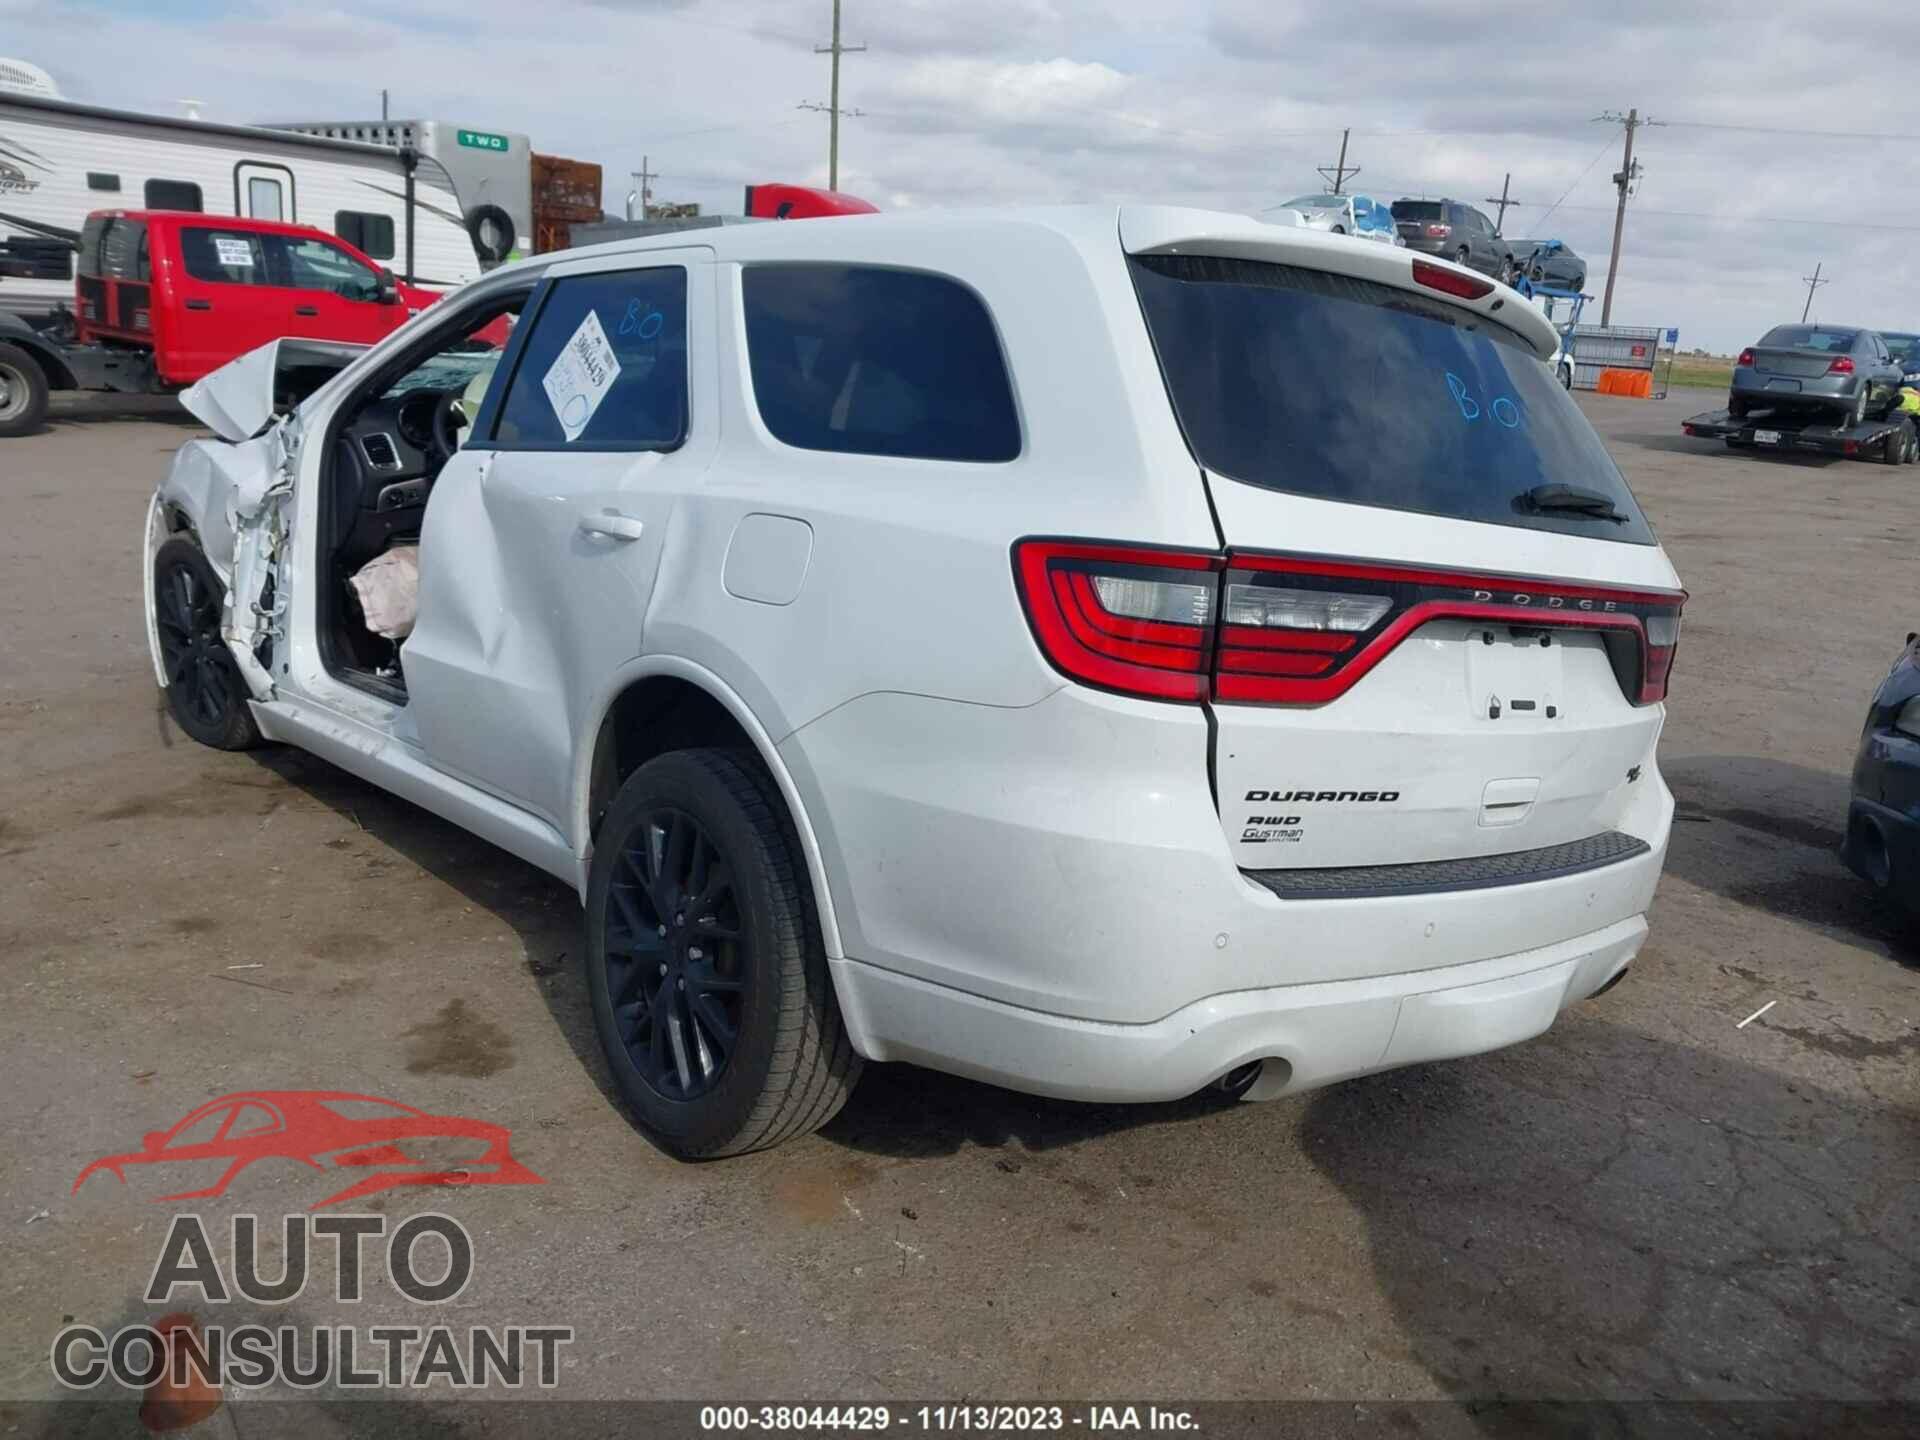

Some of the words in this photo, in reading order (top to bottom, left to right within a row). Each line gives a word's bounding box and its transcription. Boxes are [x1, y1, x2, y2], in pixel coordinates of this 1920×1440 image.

[466, 134, 501, 148] TWO
[1473, 590, 1617, 612] DODGE
[1244, 790, 1400, 802] DURANGO
[1246, 816, 1301, 825] AWD
